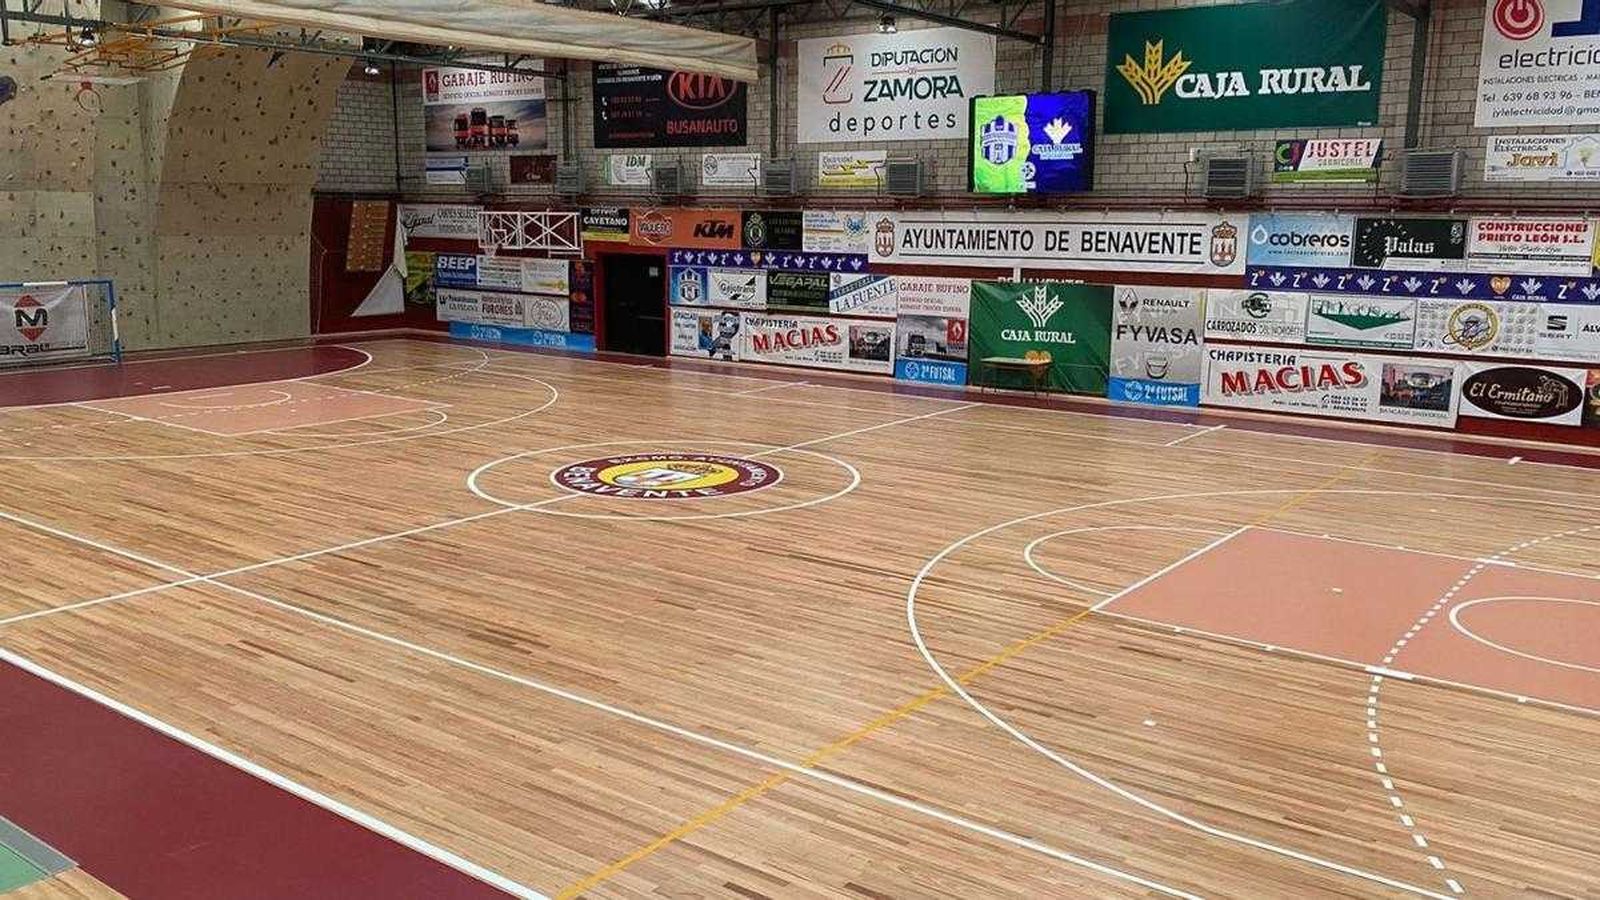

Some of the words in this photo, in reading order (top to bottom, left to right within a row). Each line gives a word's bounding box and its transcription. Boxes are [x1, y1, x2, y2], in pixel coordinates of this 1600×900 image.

[442, 71, 486, 87] GARAJE
[679, 71, 726, 100] KIA
[1175, 72, 1250, 99] CAJA
[1257, 64, 1371, 95] RURAL
[863, 75, 964, 102] ZAMORA
[1503, 92, 1522, 102] 639
[1525, 91, 1540, 101] 68
[1543, 90, 1556, 101] 93
[1560, 90, 1573, 100] 96
[666, 119, 739, 134] BUSANAUTO
[828, 110, 957, 136] deportes
[1495, 137, 1566, 145] INSTALACIONES
[1307, 141, 1374, 158] JUSTEL
[583, 216, 628, 227] CAYETANO
[693, 219, 734, 239] KTM
[1478, 222, 1588, 233] CONSTRUCCIONES
[901, 228, 1034, 252] AYUNTAMIENTO
[1045, 230, 1070, 252] DE
[1081, 231, 1202, 256] BENAVENTE
[1269, 231, 1350, 248] cobreros
[1384, 235, 1435, 256] Palas
[1479, 233, 1523, 243] PRIETO
[1526, 233, 1559, 244] LEÓN
[1563, 234, 1585, 244] S.L.
[438, 255, 476, 270] BEEP
[768, 274, 829, 290] VEGAPAL
[899, 282, 934, 292] GARAJE
[936, 284, 970, 293] RUFINO
[1142, 298, 1190, 308] RENAULT
[744, 317, 798, 329] CHAPISTERIA
[1206, 319, 1257, 333] CARROZADOS
[753, 324, 839, 353] MACIAS
[1001, 328, 1032, 341] CAJA
[1034, 331, 1076, 344] RURAL
[1117, 324, 1199, 345] FYVASA
[1209, 349, 1297, 366] CHAPISTERIA
[1221, 361, 1367, 396] MACIAS
[1155, 385, 1189, 402] FUTSAL
[1470, 382, 1486, 397] El
[563, 466, 726, 498] BENAVENTE
